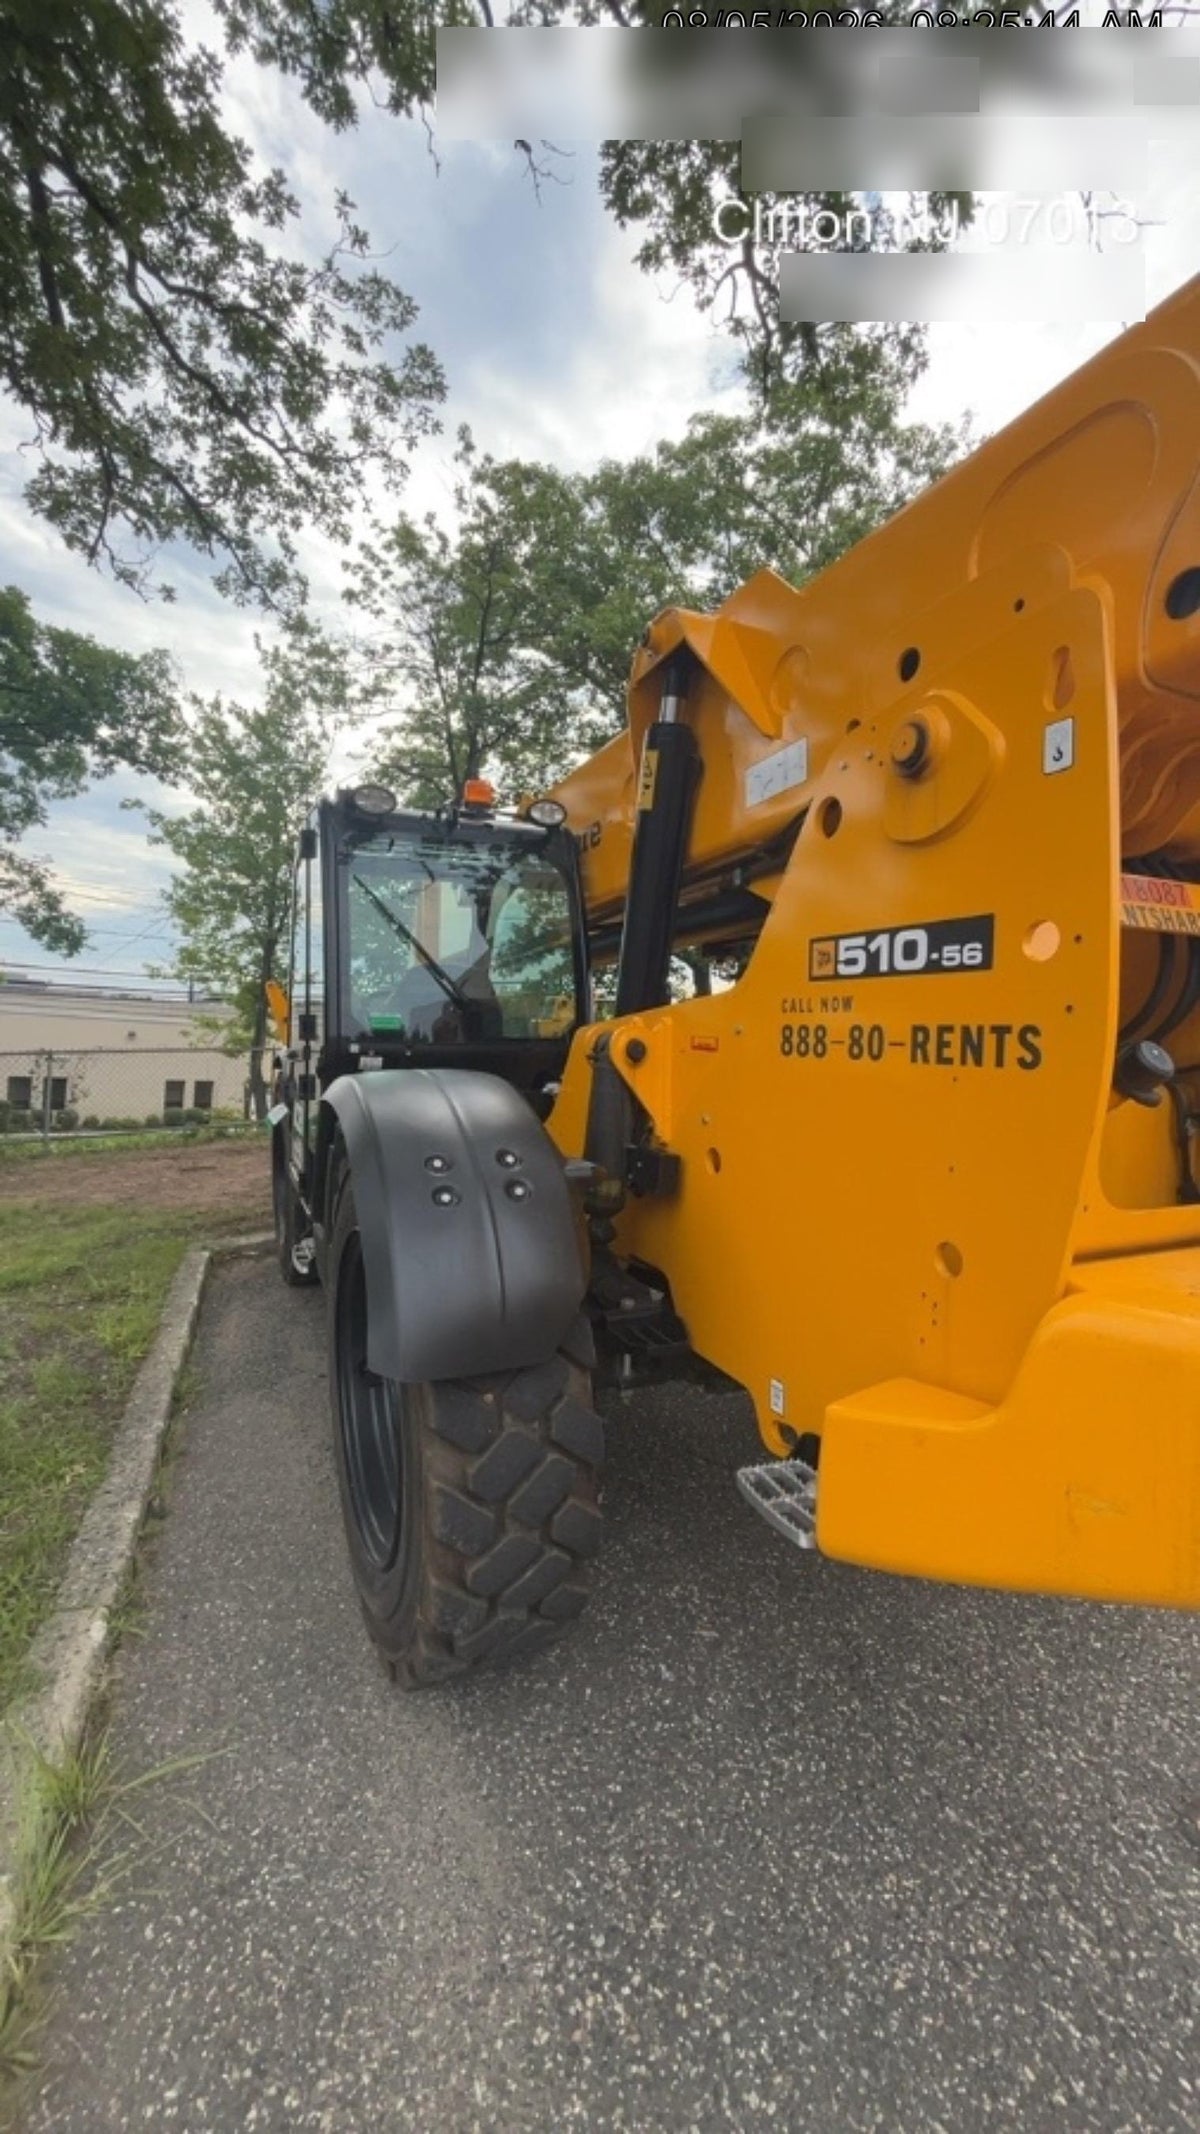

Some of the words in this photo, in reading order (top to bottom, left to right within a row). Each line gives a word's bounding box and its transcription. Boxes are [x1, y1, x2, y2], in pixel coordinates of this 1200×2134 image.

[836, 928, 984, 976] 510-56
[781, 998, 814, 1014] CALL
[820, 996, 854, 1013] NOW
[780, 1024, 1043, 1070] 888-80-RENTS
